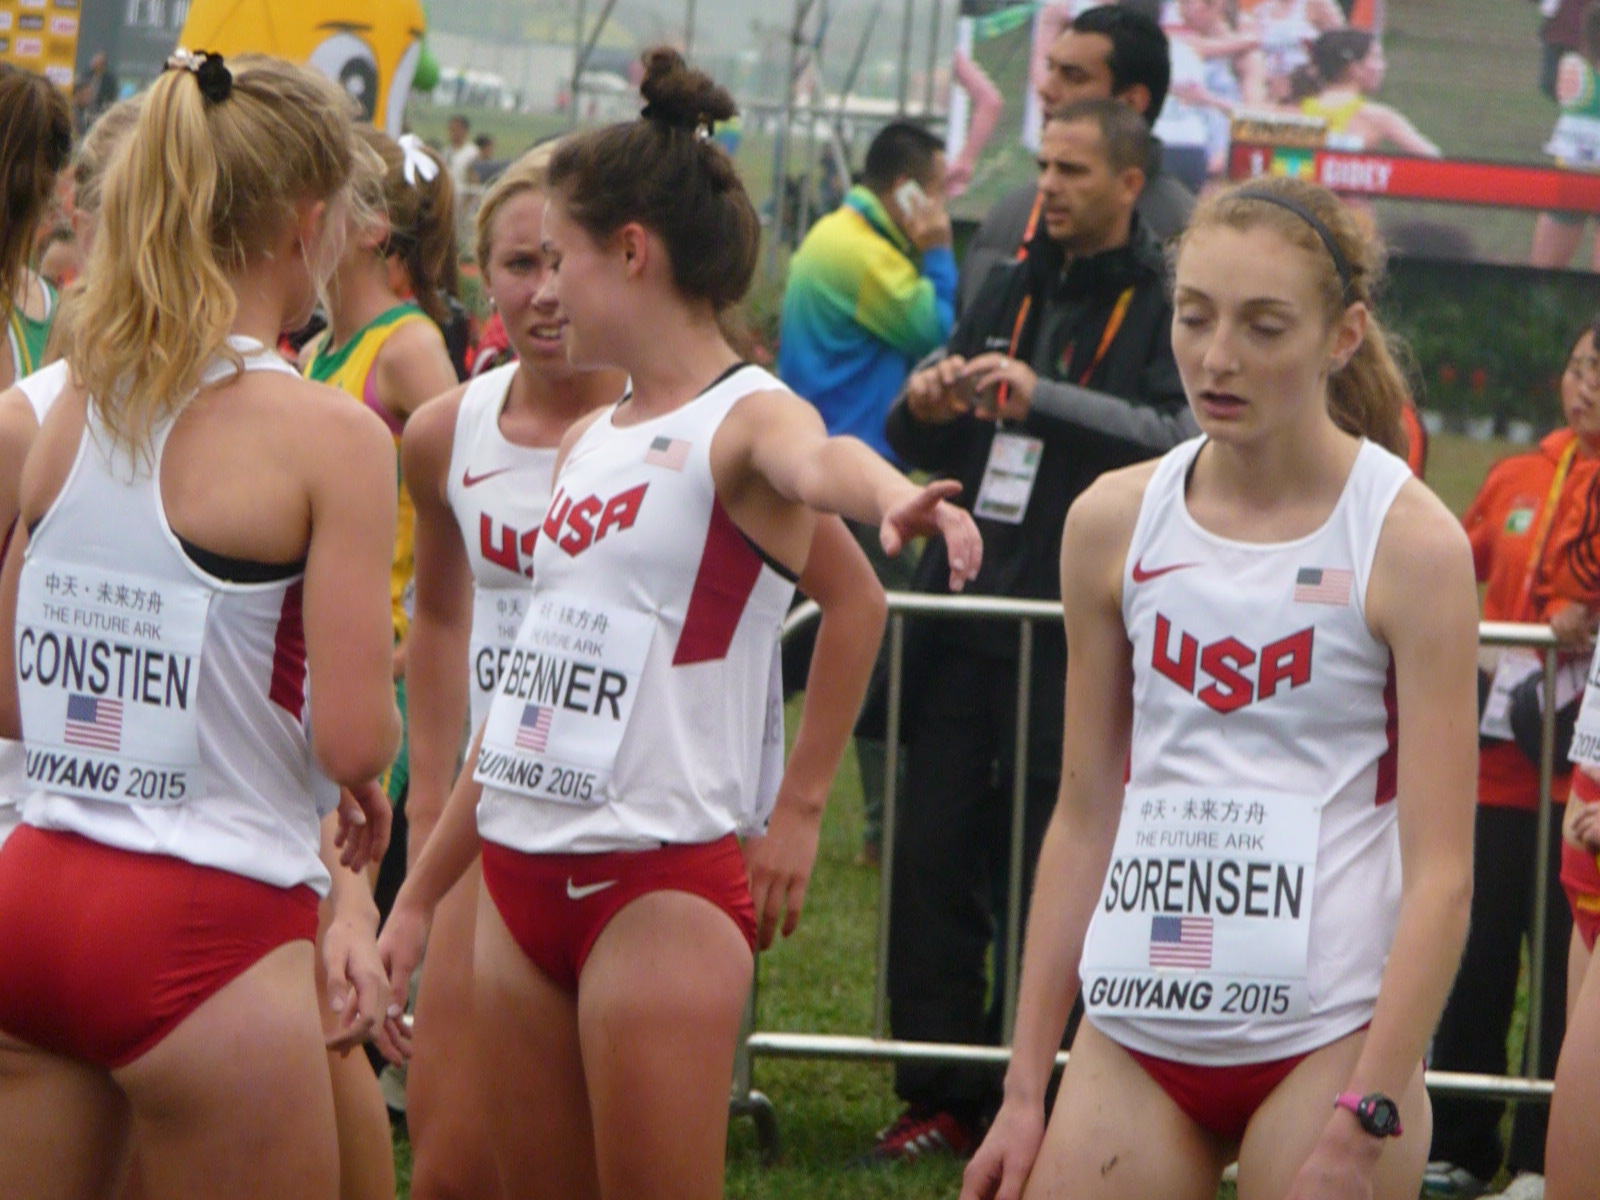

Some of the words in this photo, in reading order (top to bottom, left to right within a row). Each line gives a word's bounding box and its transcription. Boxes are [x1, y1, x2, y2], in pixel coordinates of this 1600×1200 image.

[543, 482, 649, 558] USA
[42, 603, 71, 625] THE
[73, 608, 130, 634] FUTURE
[132, 622, 162, 641] ARK
[18, 627, 192, 711] CONSTIEN
[502, 649, 628, 721] BENNER
[1151, 611, 1315, 716] USA
[26, 750, 121, 793] UIYANG
[124, 767, 187, 801] 2015
[545, 766, 598, 801] 2015
[1136, 831, 1157, 847] THE
[1159, 831, 1219, 849] FUTURE
[1224, 834, 1265, 851] ARK
[1104, 857, 1305, 920] SORENSEN
[1088, 976, 1214, 1012] GUIYANG
[1220, 982, 1292, 1016] 2015
